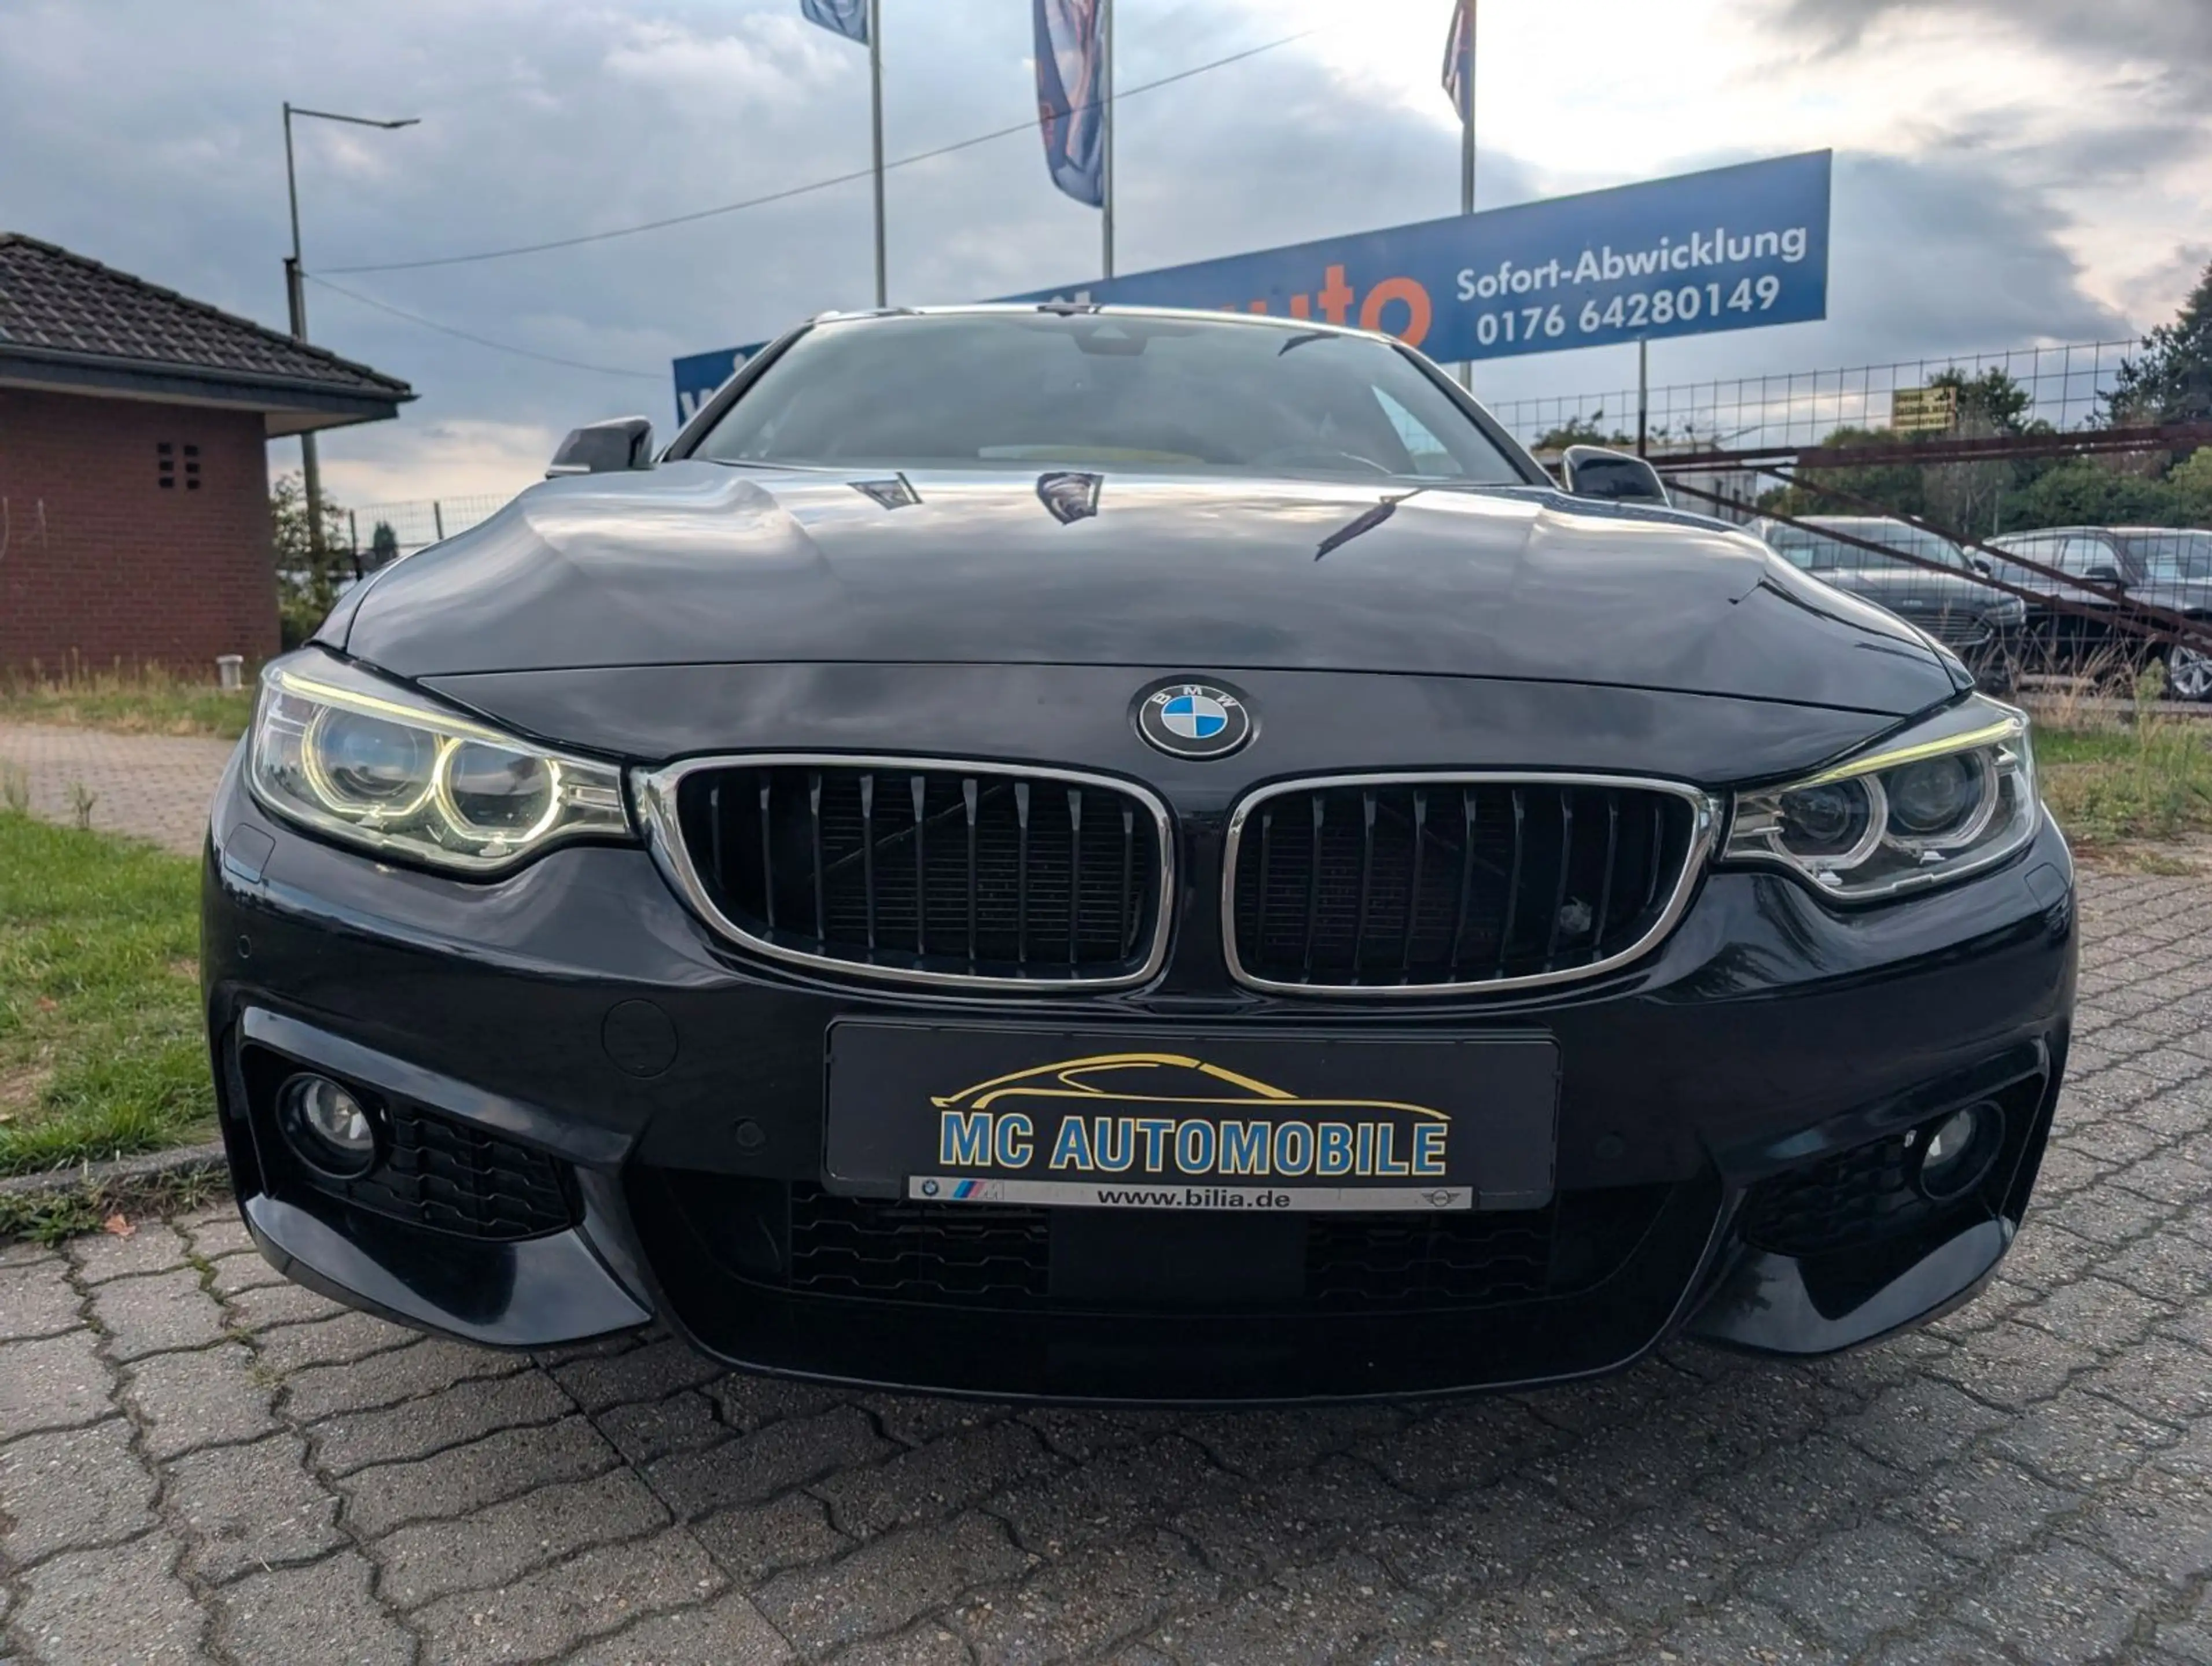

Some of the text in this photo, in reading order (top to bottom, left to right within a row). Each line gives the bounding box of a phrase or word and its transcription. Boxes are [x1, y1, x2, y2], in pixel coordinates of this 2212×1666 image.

[1456, 227, 1807, 301] Sofort-Abwicklung
[1477, 275, 1780, 345] 0176 64280149
[1151, 685, 1239, 707] BMW
[939, 1110, 1448, 1177] MC AUTOMOBILE
[1098, 1188, 1291, 1208] www.bilia.de
